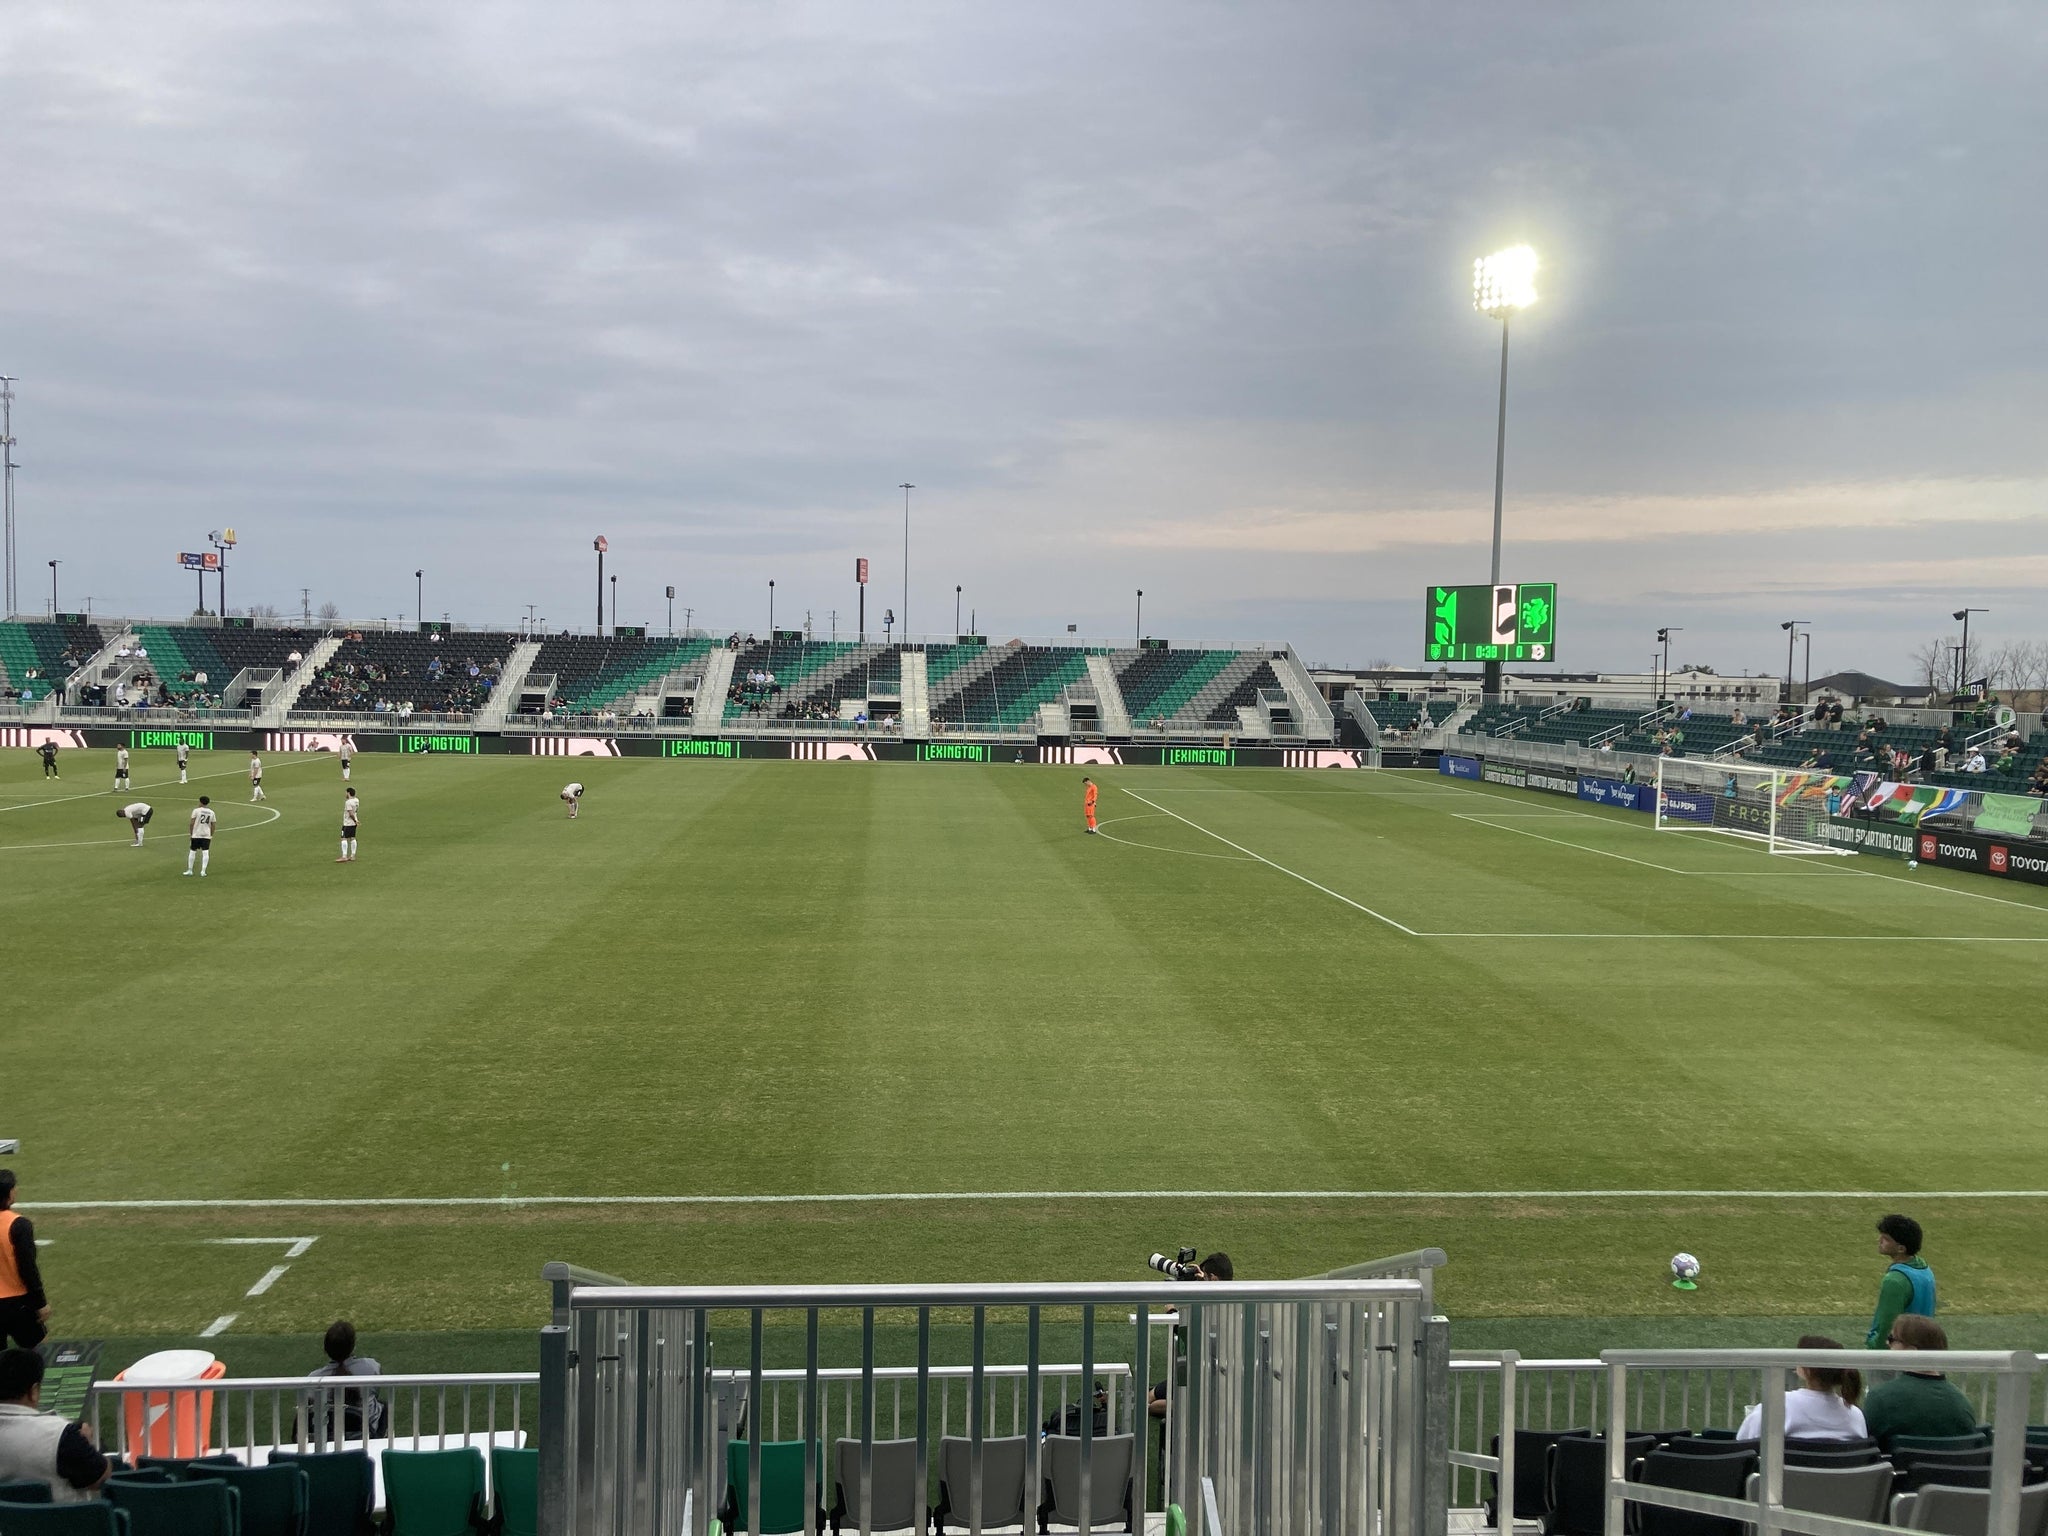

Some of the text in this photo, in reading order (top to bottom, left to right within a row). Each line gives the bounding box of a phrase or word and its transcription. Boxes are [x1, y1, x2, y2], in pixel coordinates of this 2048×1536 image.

[141, 732, 204, 749] LEXINGTON
[671, 741, 732, 758] LEXINGTON
[925, 745, 983, 762] LEXINGTON
[1170, 749, 1227, 766] LEXINGTON
[200, 814, 211, 825] 24
[1817, 822, 1854, 843] LEXINGTON
[1893, 834, 1914, 854] CLUB
[1939, 843, 1978, 861] TOYOTA
